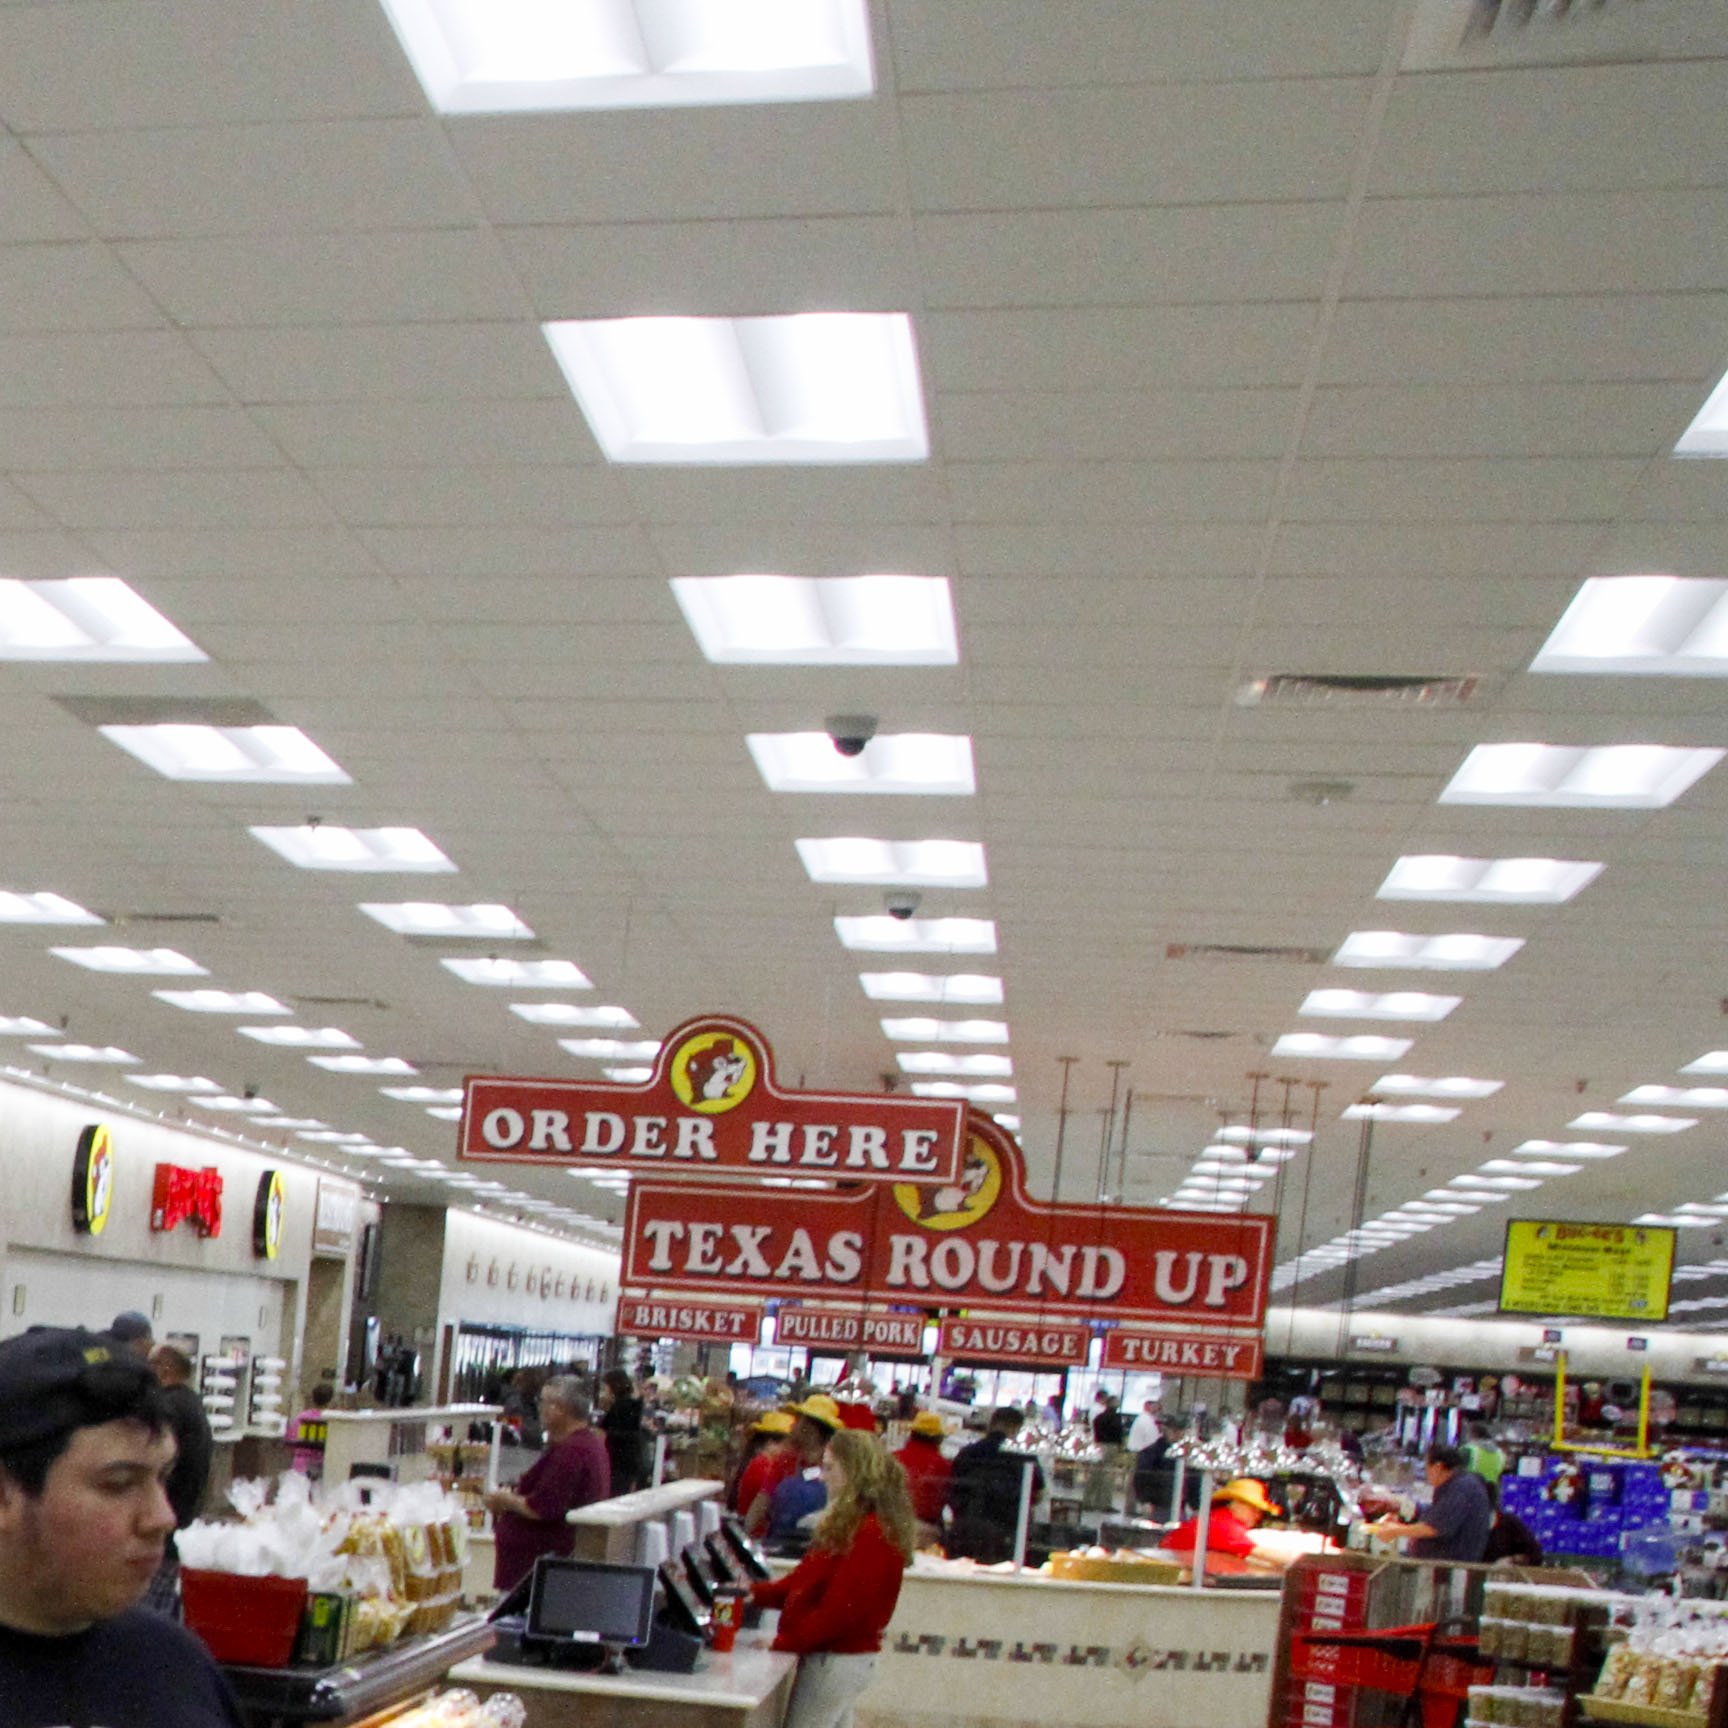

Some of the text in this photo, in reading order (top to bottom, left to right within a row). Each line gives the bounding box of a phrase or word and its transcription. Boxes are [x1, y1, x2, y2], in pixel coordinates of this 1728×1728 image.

[482, 1107, 939, 1173] ORDER HERE
[644, 1219, 1249, 1305] TEXAS ROUND UP
[634, 1304, 746, 1336] BRISKET
[782, 1316, 917, 1344] PULLED PORK
[950, 1326, 1078, 1357] SAUSAGE
[1122, 1338, 1241, 1368] TURKEY
